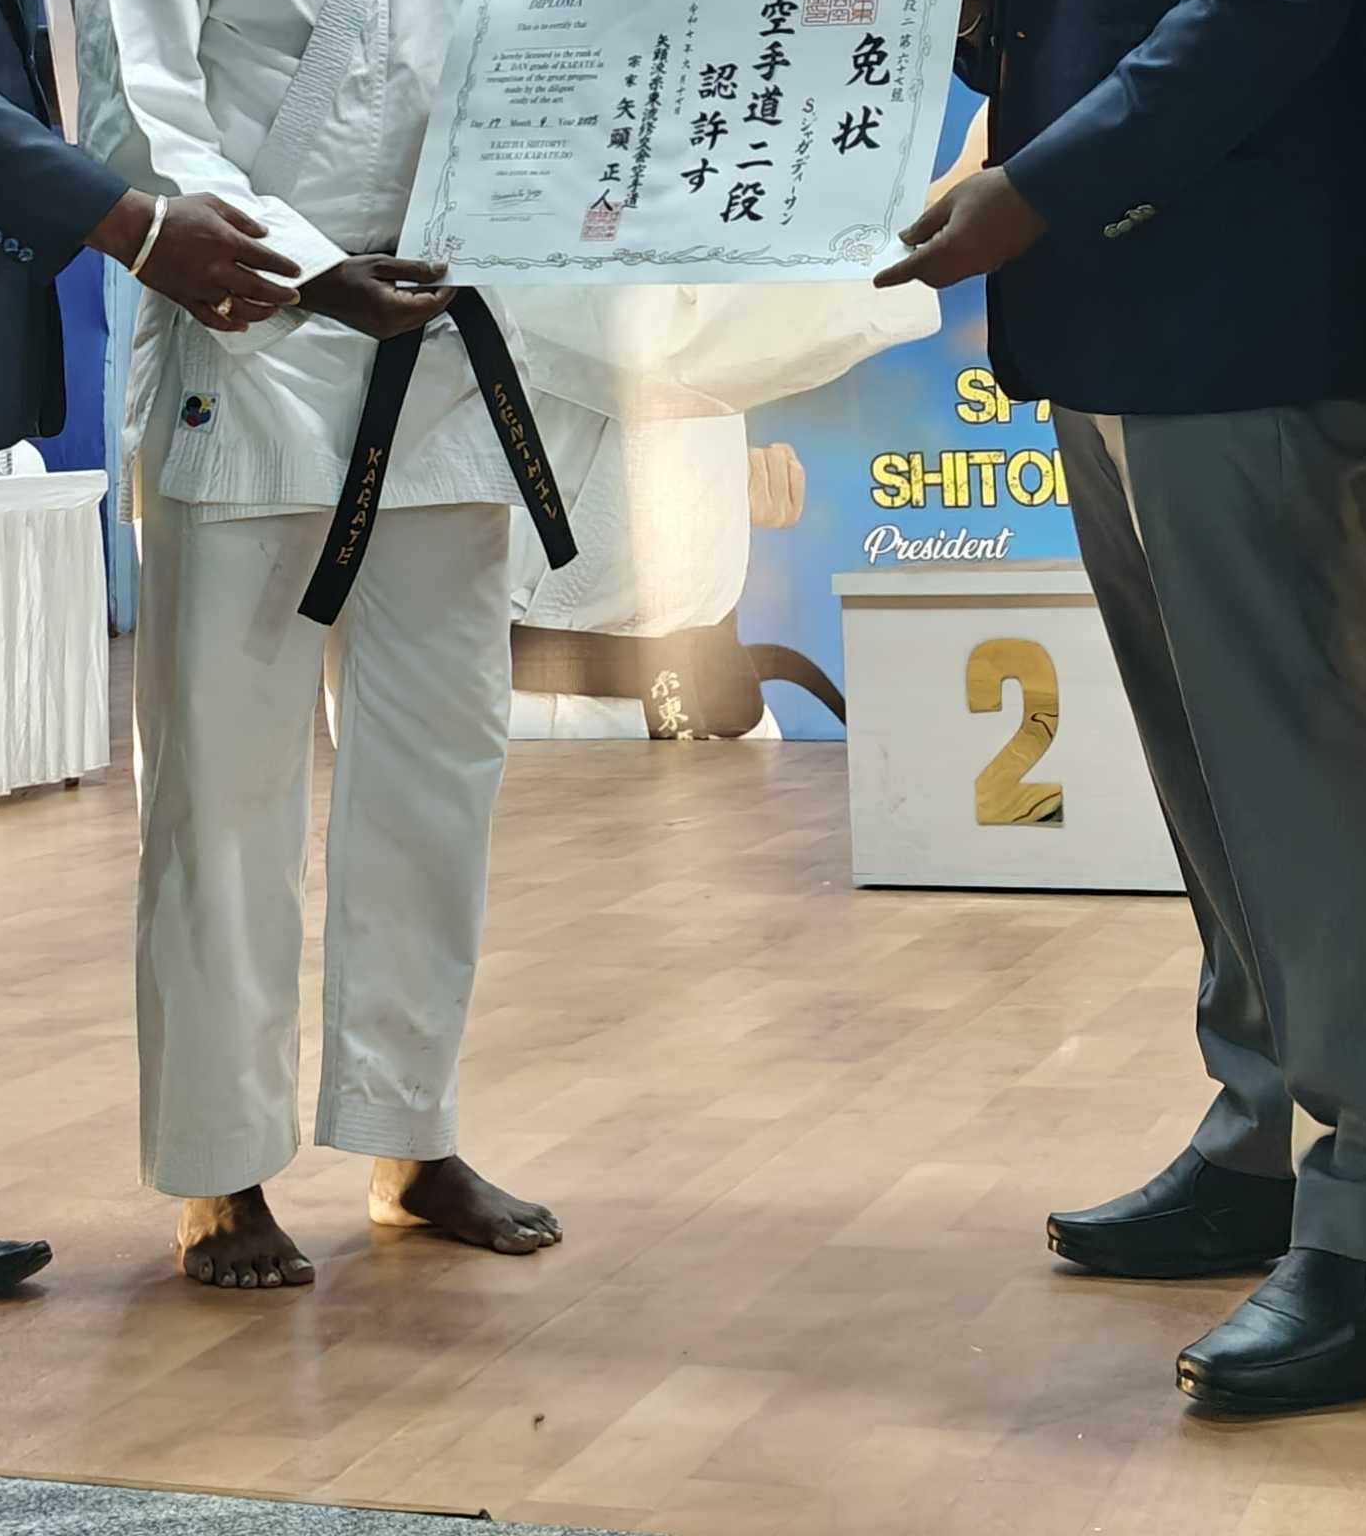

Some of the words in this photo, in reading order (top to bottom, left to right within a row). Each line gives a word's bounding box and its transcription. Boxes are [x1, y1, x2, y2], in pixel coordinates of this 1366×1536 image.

[680, 62, 739, 194] 認許す
[831, 31, 891, 156] 免状
[336, 447, 384, 566] KARATE
[870, 448, 1071, 509] SHITO
[863, 524, 1015, 565] President
[965, 638, 1065, 829] 2
